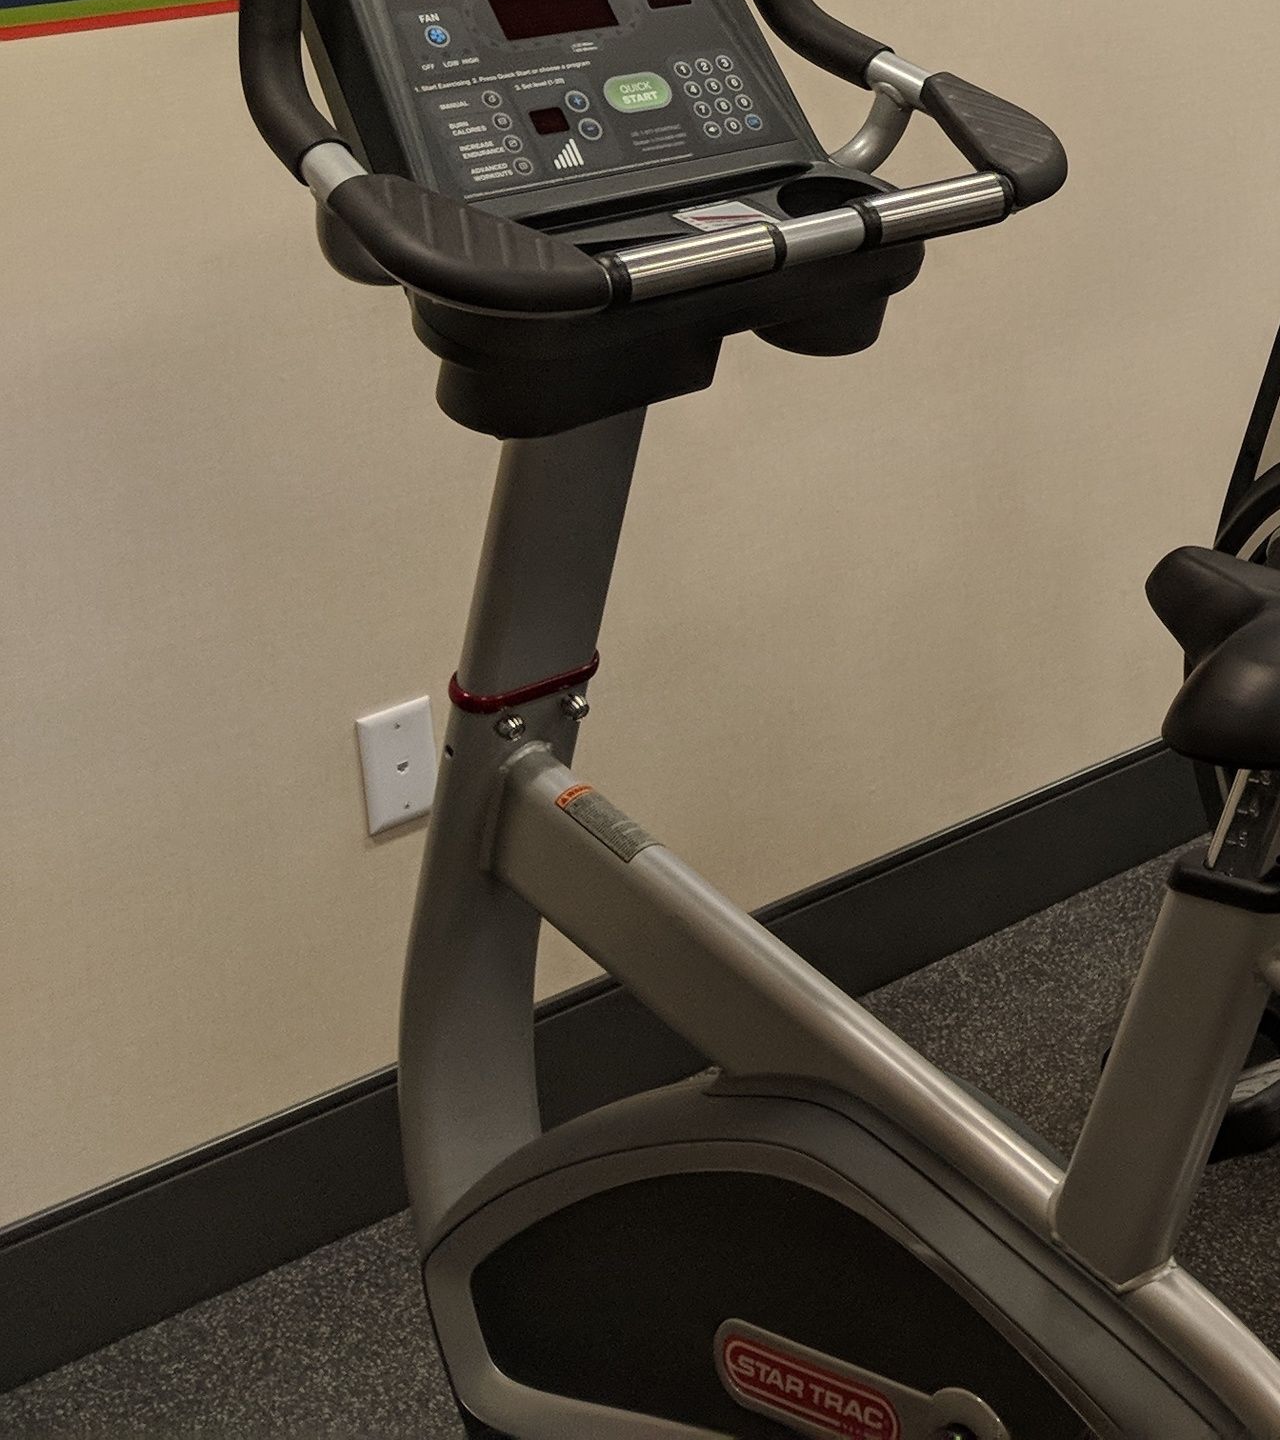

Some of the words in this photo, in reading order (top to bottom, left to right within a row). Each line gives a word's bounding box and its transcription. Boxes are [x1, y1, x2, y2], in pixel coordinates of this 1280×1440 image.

[418, 12, 440, 24] FAN
[619, 81, 652, 94] QUICK
[622, 91, 659, 104] START
[438, 100, 470, 110] MANUAL
[452, 125, 487, 137] CALORIES
[459, 140, 495, 152] INCREASE
[462, 146, 506, 160] ENDURANCE
[470, 162, 508, 175] ADVANCED
[473, 168, 514, 182] WORKOUTS
[733, 1354, 805, 1398] STAR
[808, 1382, 884, 1430] TRAC
